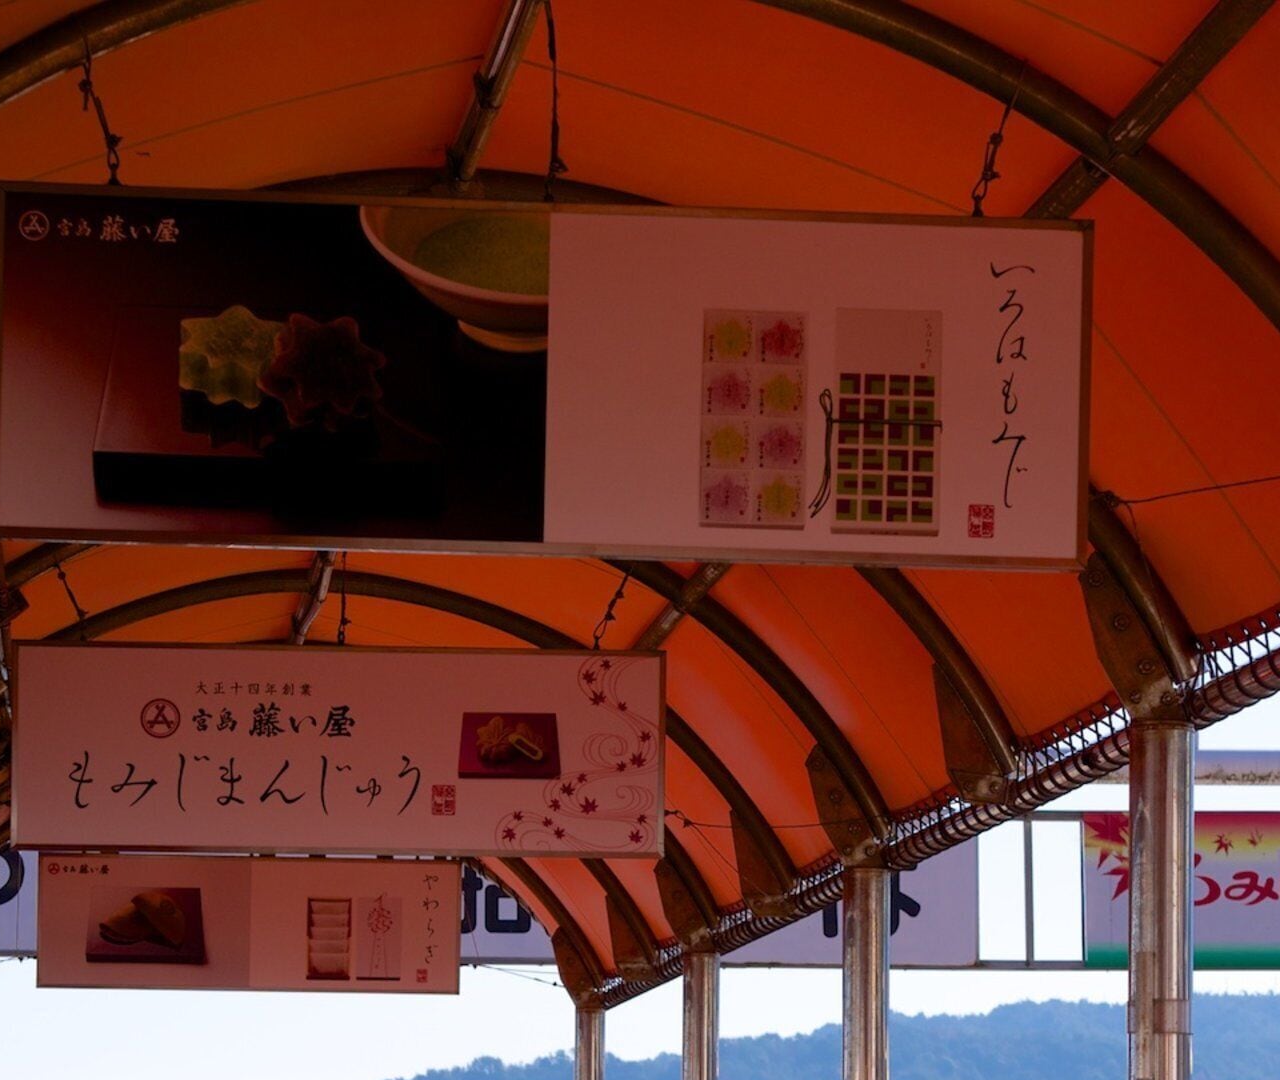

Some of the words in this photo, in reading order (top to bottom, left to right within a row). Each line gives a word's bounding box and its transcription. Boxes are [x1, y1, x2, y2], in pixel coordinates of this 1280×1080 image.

[99, 213, 180, 243] 藤い屋
[194, 680, 313, 697] 大正十四年創業
[191, 707, 239, 732] 宮島
[248, 701, 356, 738] 藤い屋
[67, 750, 423, 816] もみじまんじゅう
[421, 874, 440, 965] やわらぎ
